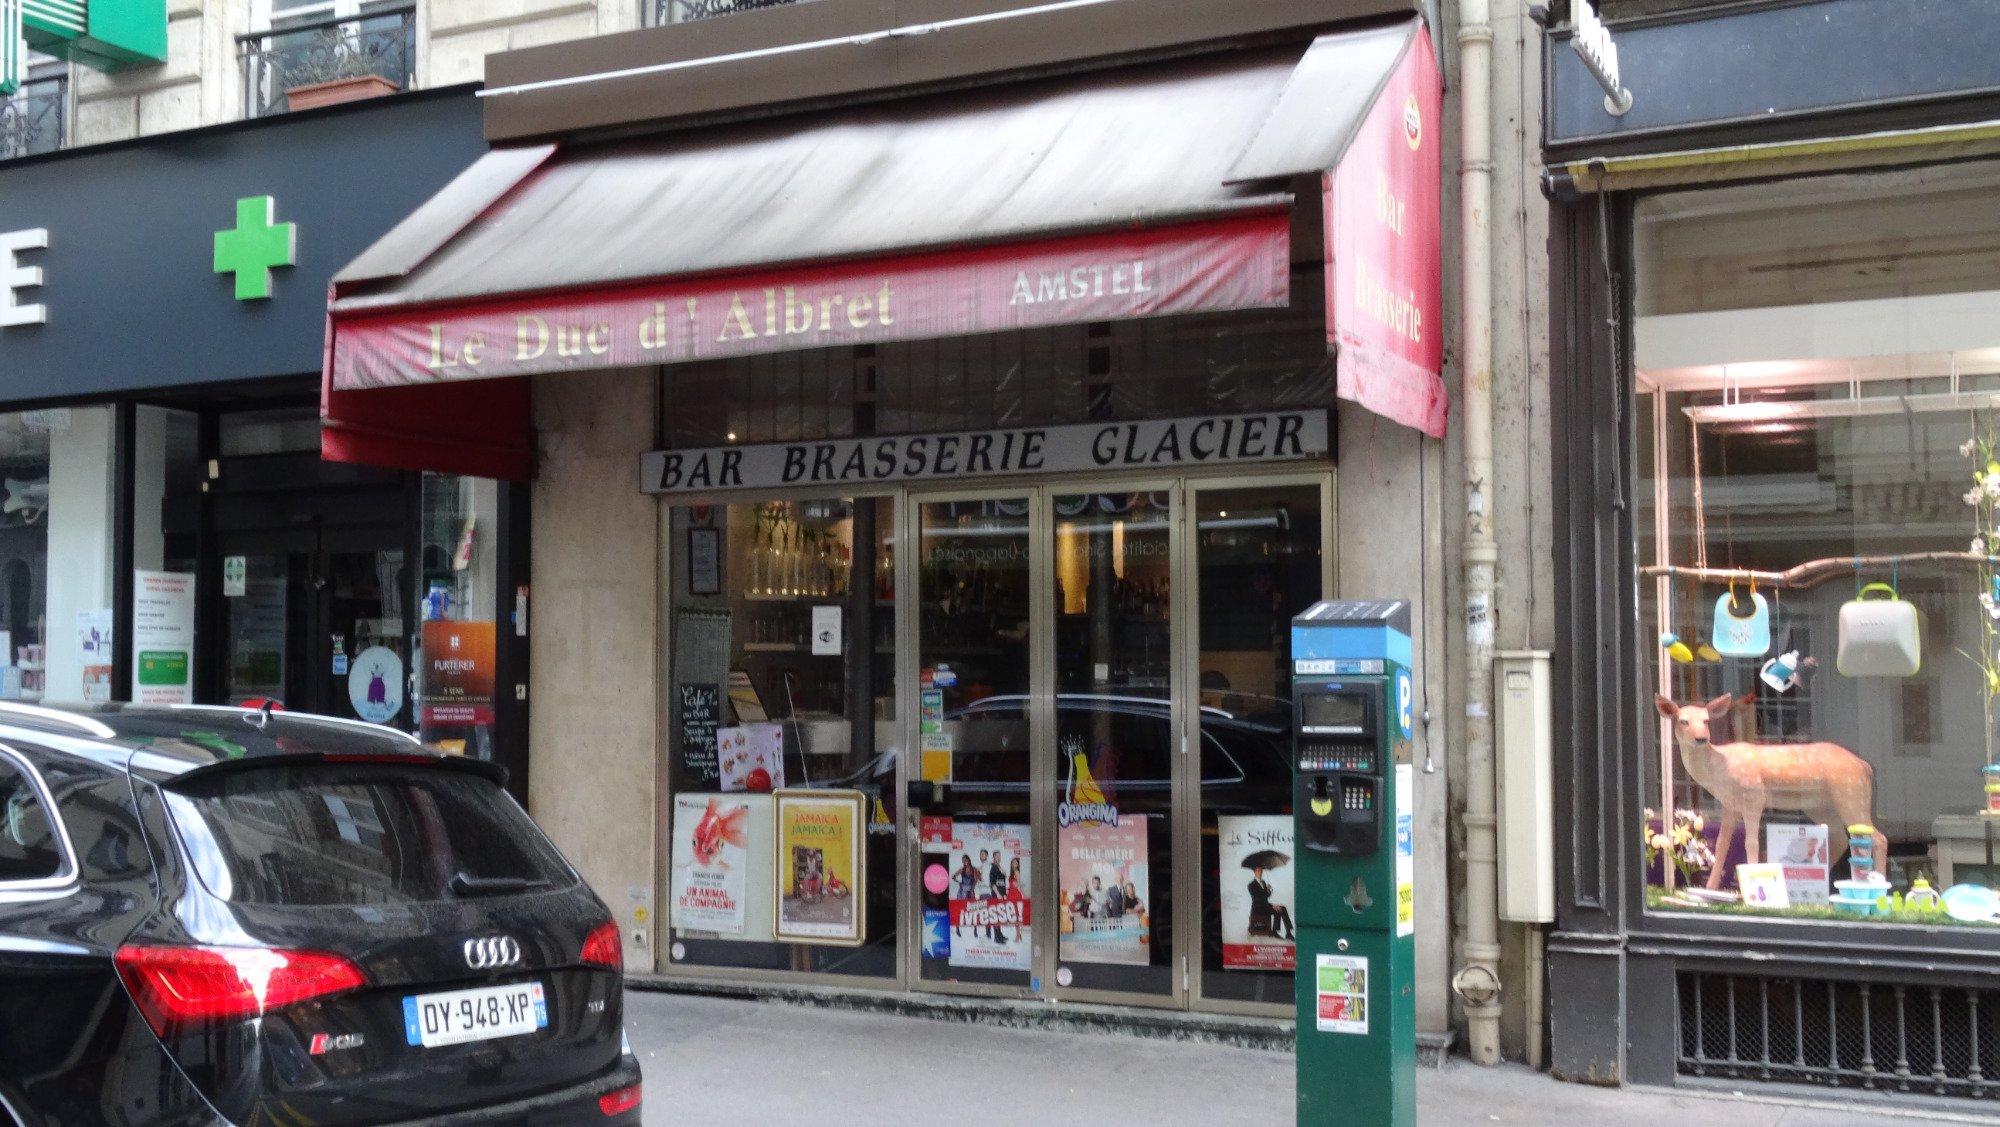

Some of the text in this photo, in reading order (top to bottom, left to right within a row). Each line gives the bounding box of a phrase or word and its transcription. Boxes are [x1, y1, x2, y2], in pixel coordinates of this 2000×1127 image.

[1375, 168, 1405, 236] Bar
[1009, 259, 1152, 305] AMSTEL
[1354, 254, 1422, 343] Brasserie
[428, 321, 487, 370] Le
[514, 314, 610, 362] Duc
[714, 280, 895, 343] Albret
[658, 414, 1306, 490] BAR BRASSERIE GLACIER
[434, 659, 475, 671] FURTERER
[794, 813, 840, 825] JAMAICA
[1058, 800, 1119, 828] ORANGINA
[791, 824, 836, 835] JAMAICA
[679, 895, 736, 910] DE COMPAGNIE
[686, 886, 729, 900] UN ANIMAL
